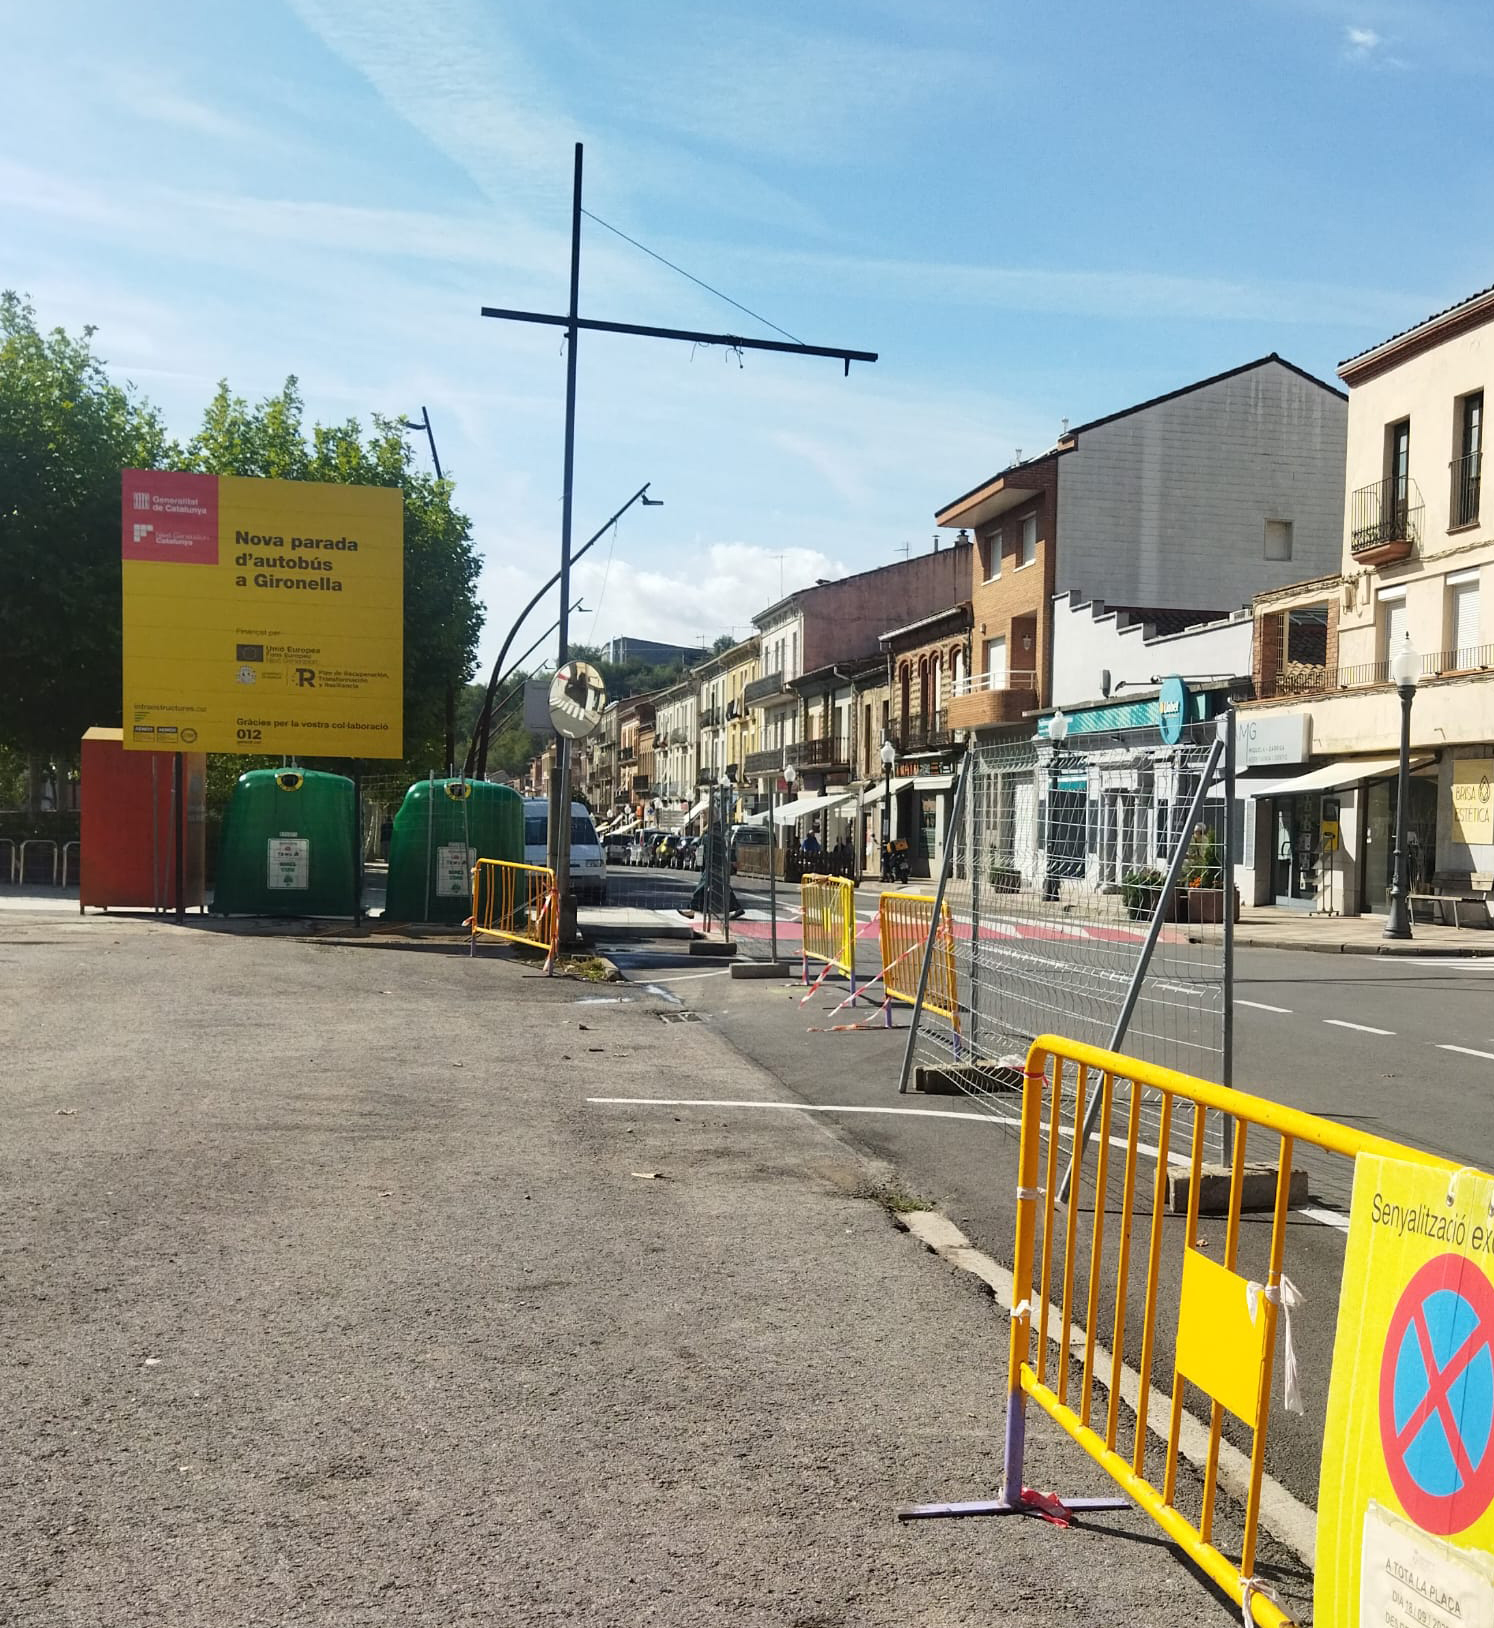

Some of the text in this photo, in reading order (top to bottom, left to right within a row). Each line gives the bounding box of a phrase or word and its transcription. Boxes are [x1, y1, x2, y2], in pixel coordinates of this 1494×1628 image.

[152, 504, 207, 516] de Catalunya
[235, 530, 358, 552] Nova parada
[235, 552, 333, 571] d'autobús
[235, 573, 342, 592] a Gironella
[287, 646, 321, 654] Europea
[236, 717, 271, 727] Gràcies
[273, 720, 288, 728] per
[291, 719, 299, 728] la
[301, 721, 329, 729] vostra
[236, 728, 262, 740] 012
[1371, 1193, 1466, 1246] Senyalització
[1385, 1557, 1392, 1571] A
[1393, 1561, 1414, 1584] TOTA
[1415, 1576, 1427, 1596] LA
[1392, 1590, 1404, 1608] DIA
